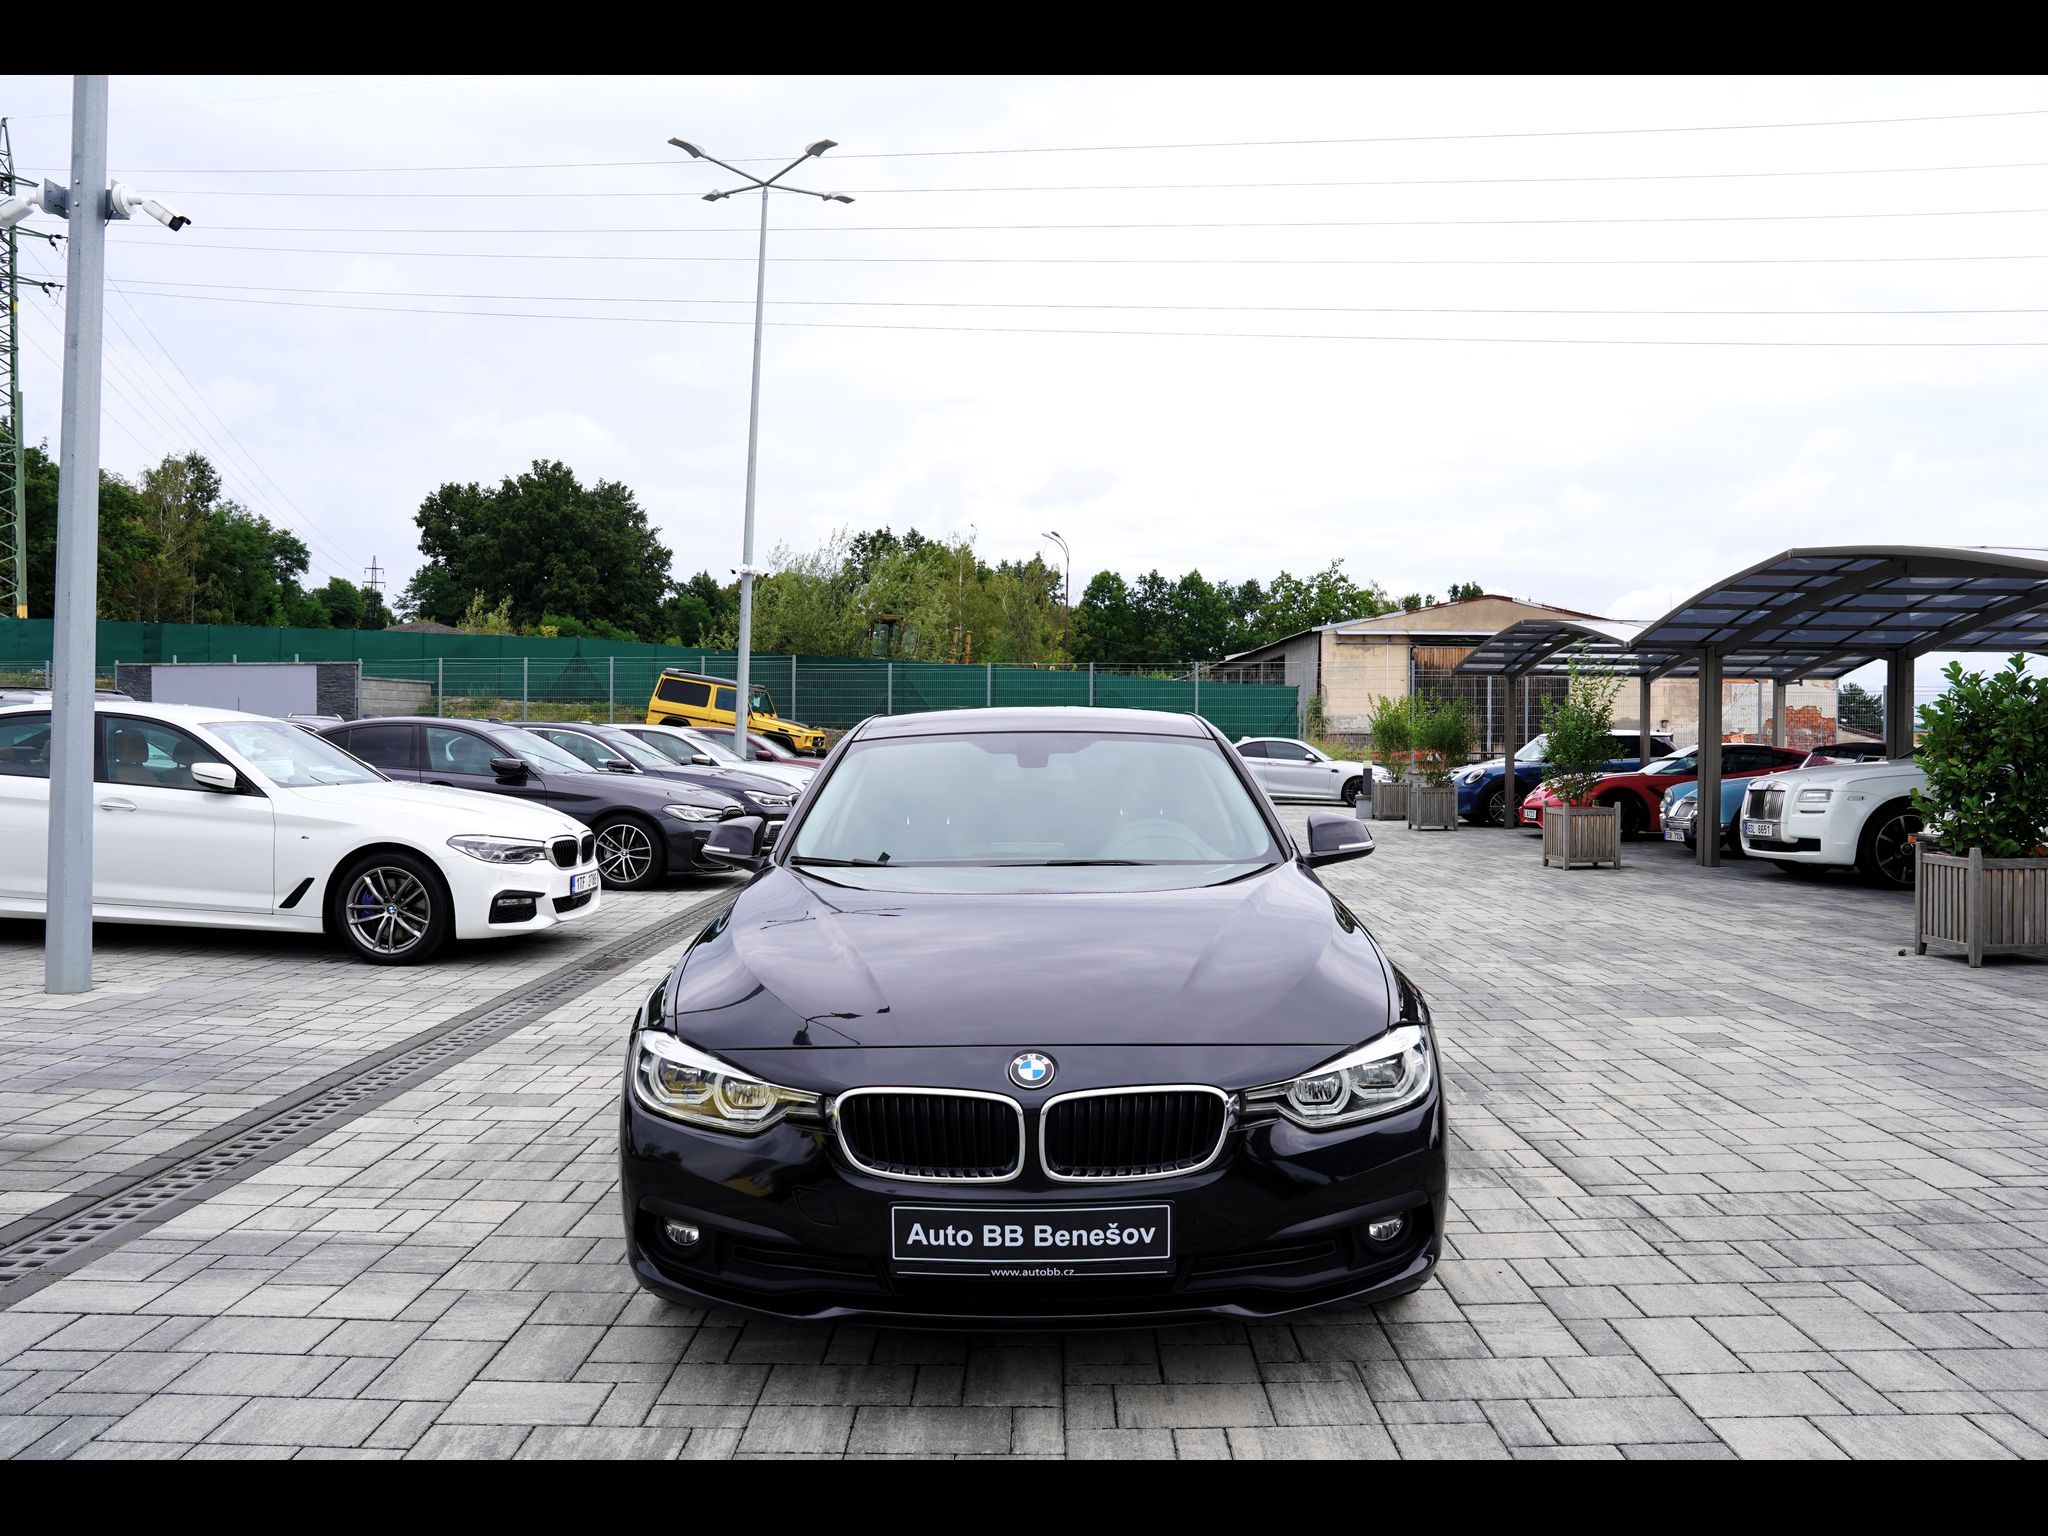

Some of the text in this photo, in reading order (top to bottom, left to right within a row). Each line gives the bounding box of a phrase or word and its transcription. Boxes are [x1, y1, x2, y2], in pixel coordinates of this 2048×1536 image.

[906, 1222, 1156, 1247] Auto BB Benešov
[990, 1267, 1075, 1277] www.autobb.cz
